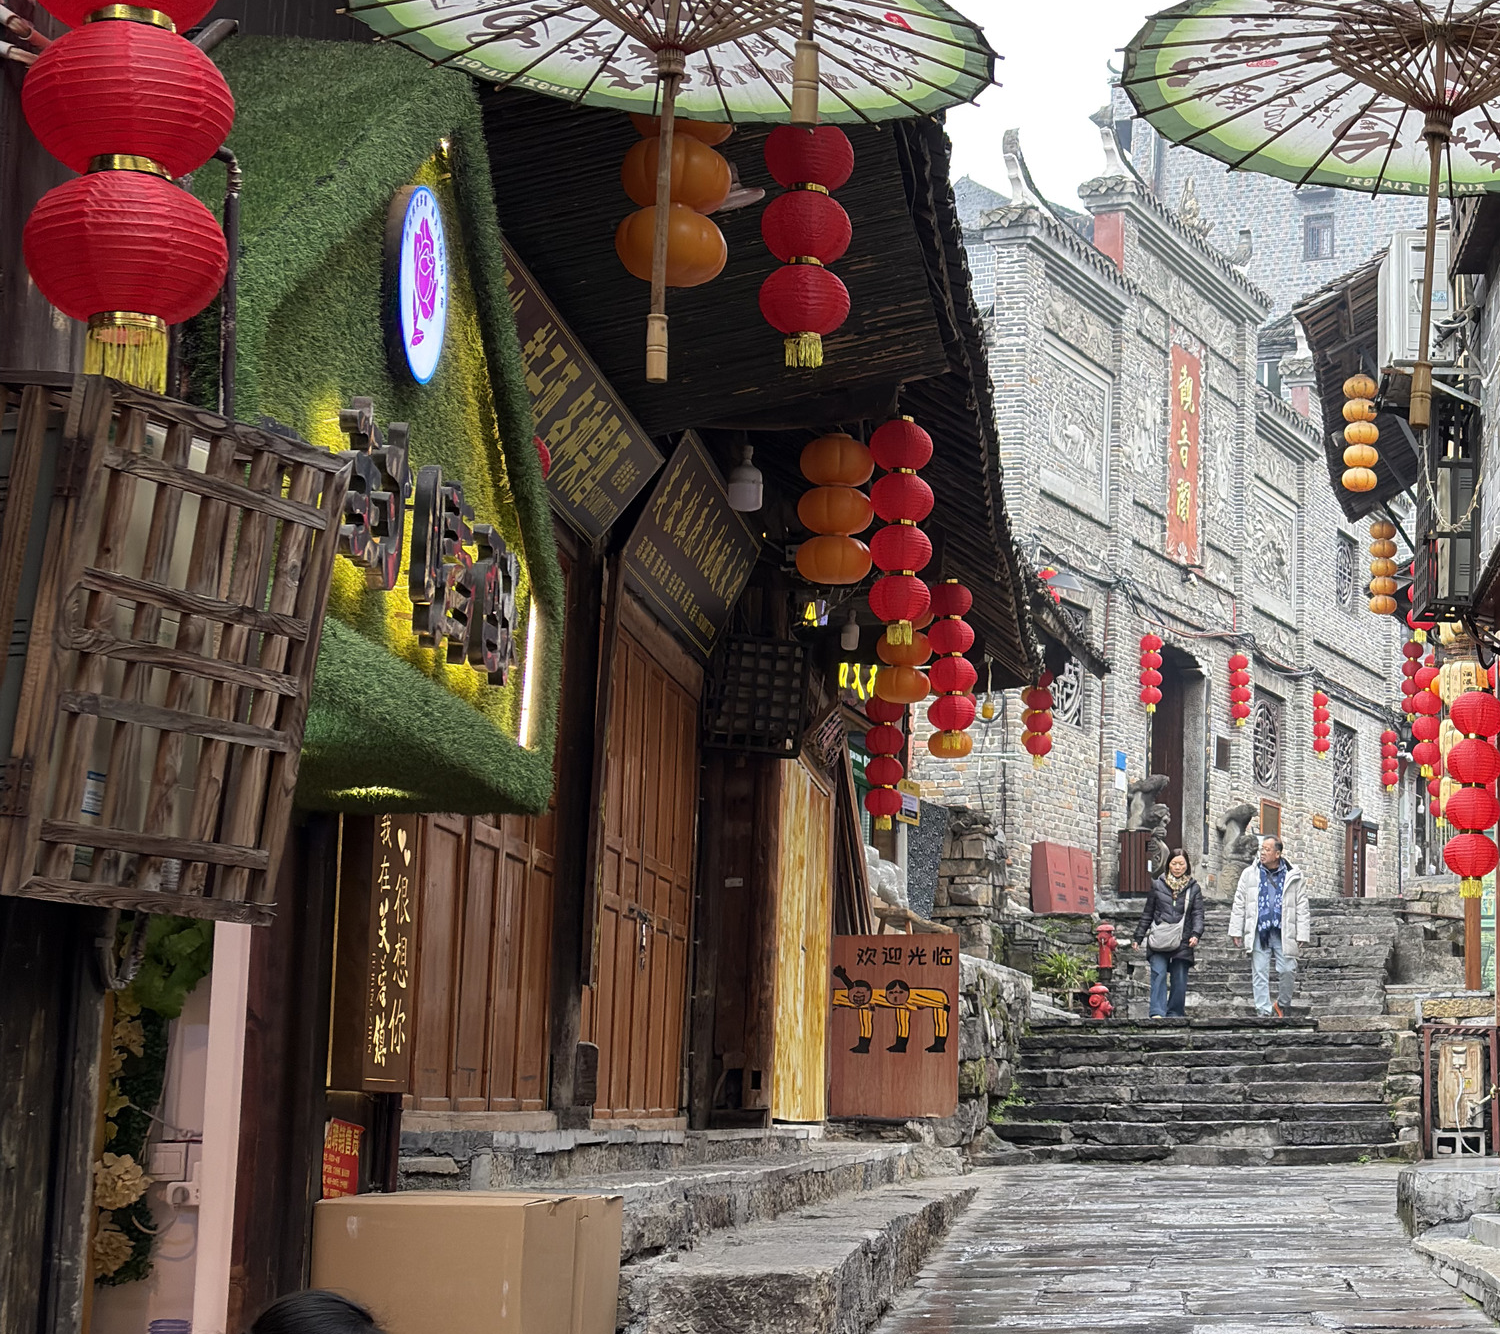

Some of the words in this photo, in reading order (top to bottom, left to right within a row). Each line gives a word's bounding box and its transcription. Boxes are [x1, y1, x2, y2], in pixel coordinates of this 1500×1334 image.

[388, 873, 412, 1056] 很想你
[856, 946, 953, 966] 欢迎光临
